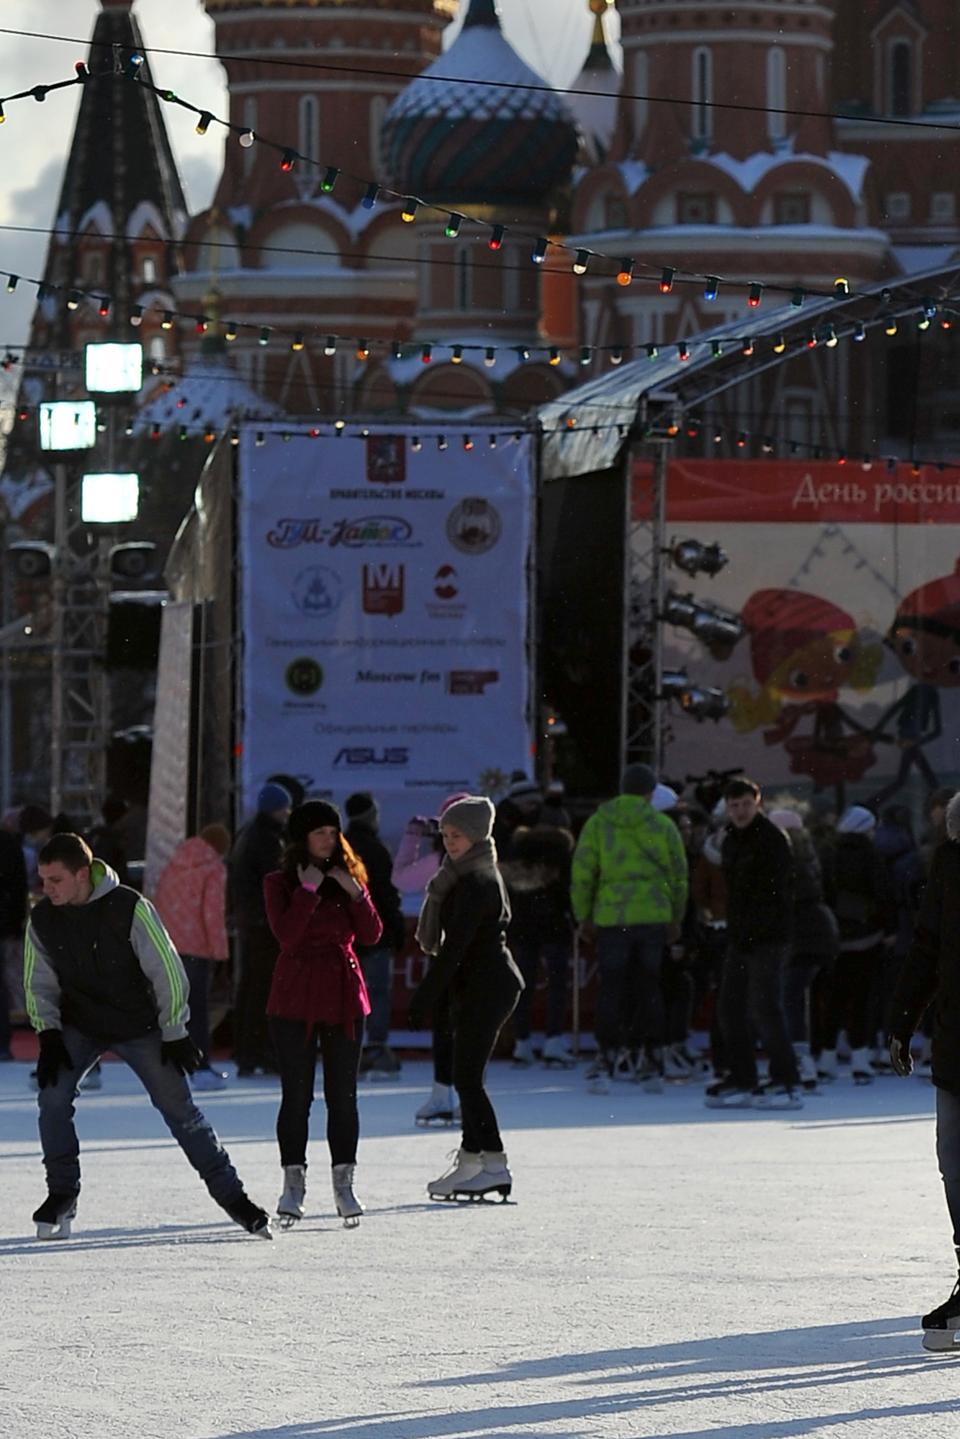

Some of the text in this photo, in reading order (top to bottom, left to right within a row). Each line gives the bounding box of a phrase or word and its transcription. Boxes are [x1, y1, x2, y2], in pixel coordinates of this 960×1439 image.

[792, 473, 867, 510] День
[355, 670, 416, 683] Moscow
[332, 747, 409, 765] ASUS
